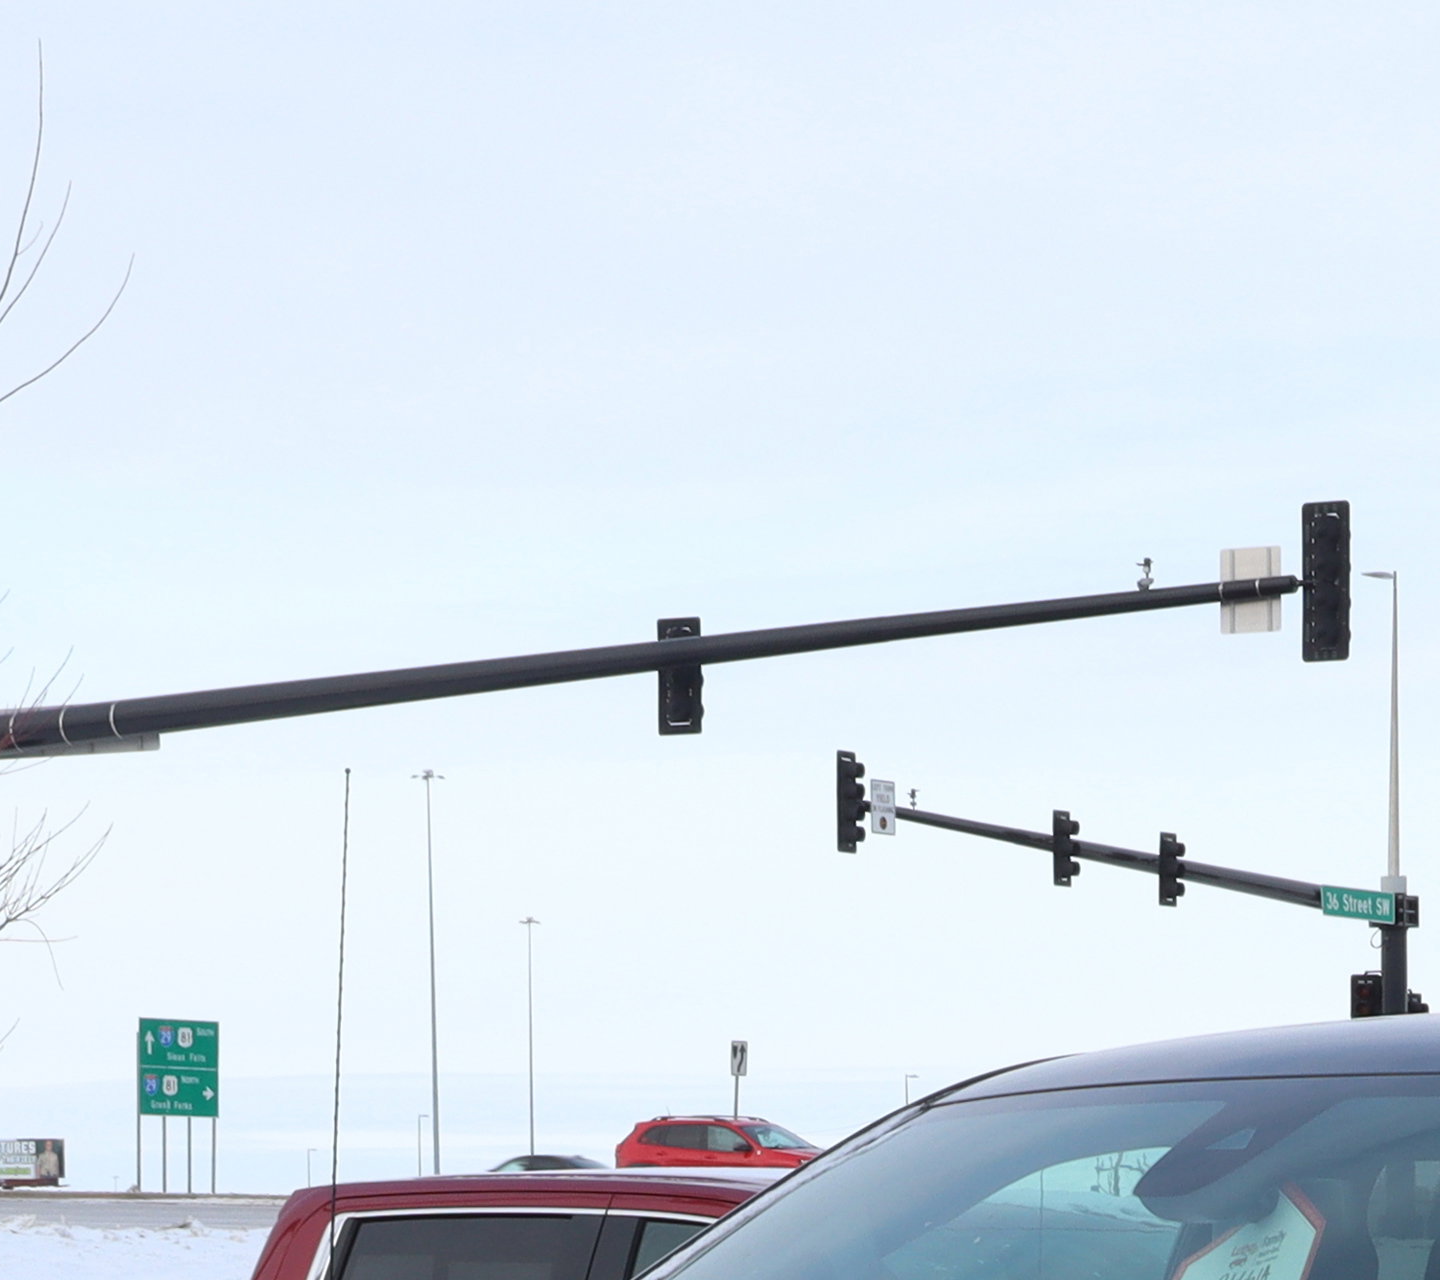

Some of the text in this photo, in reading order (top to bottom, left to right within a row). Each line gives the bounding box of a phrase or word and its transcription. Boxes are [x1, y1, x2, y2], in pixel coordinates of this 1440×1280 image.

[1326, 892, 1391, 916] 36 Street SW
